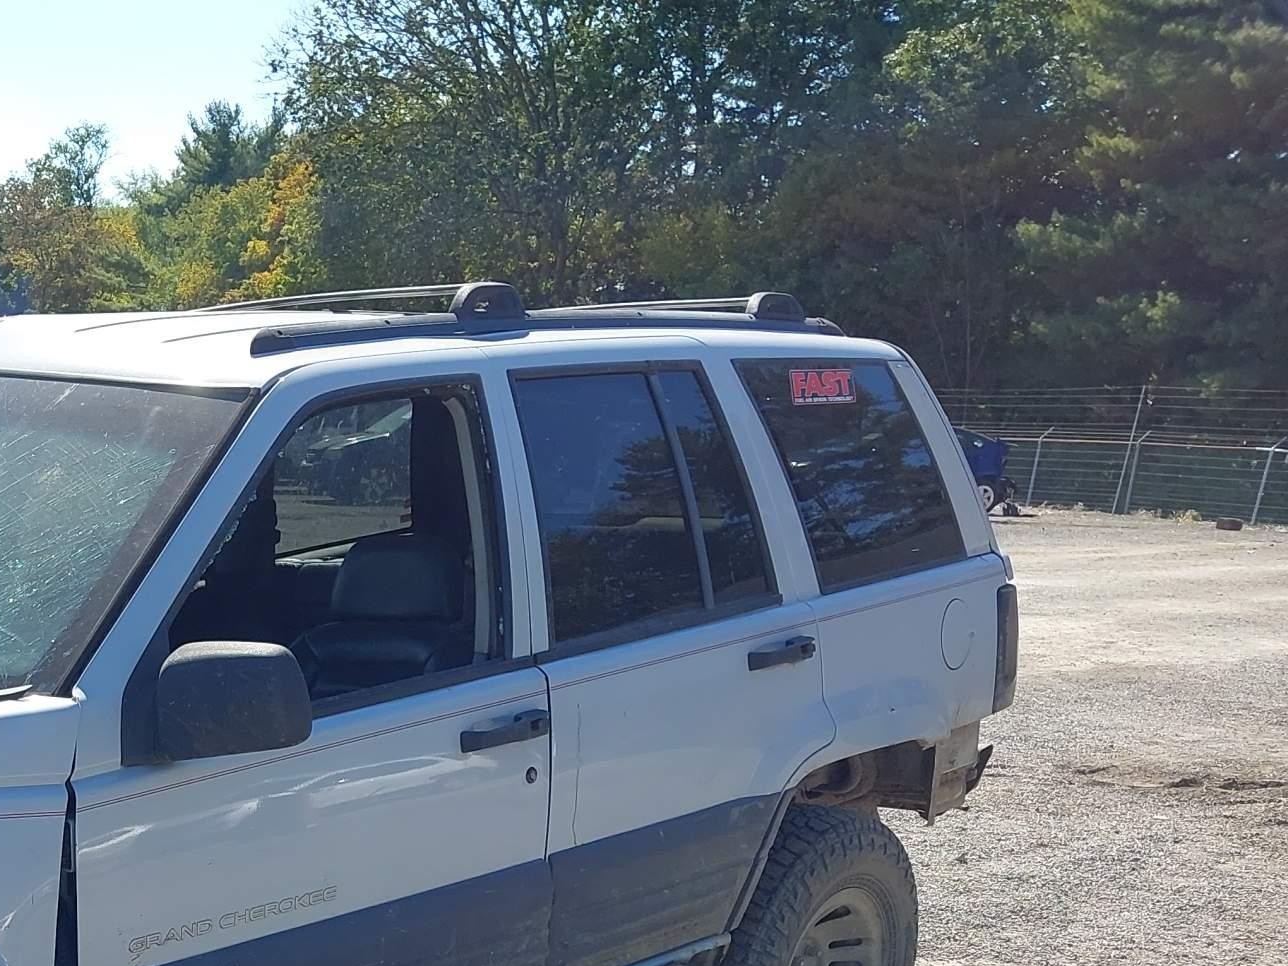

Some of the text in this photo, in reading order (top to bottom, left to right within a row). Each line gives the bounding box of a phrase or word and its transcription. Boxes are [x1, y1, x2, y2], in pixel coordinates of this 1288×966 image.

[791, 371, 851, 397] FAST
[128, 885, 338, 955] GRAND CHEROKEE
